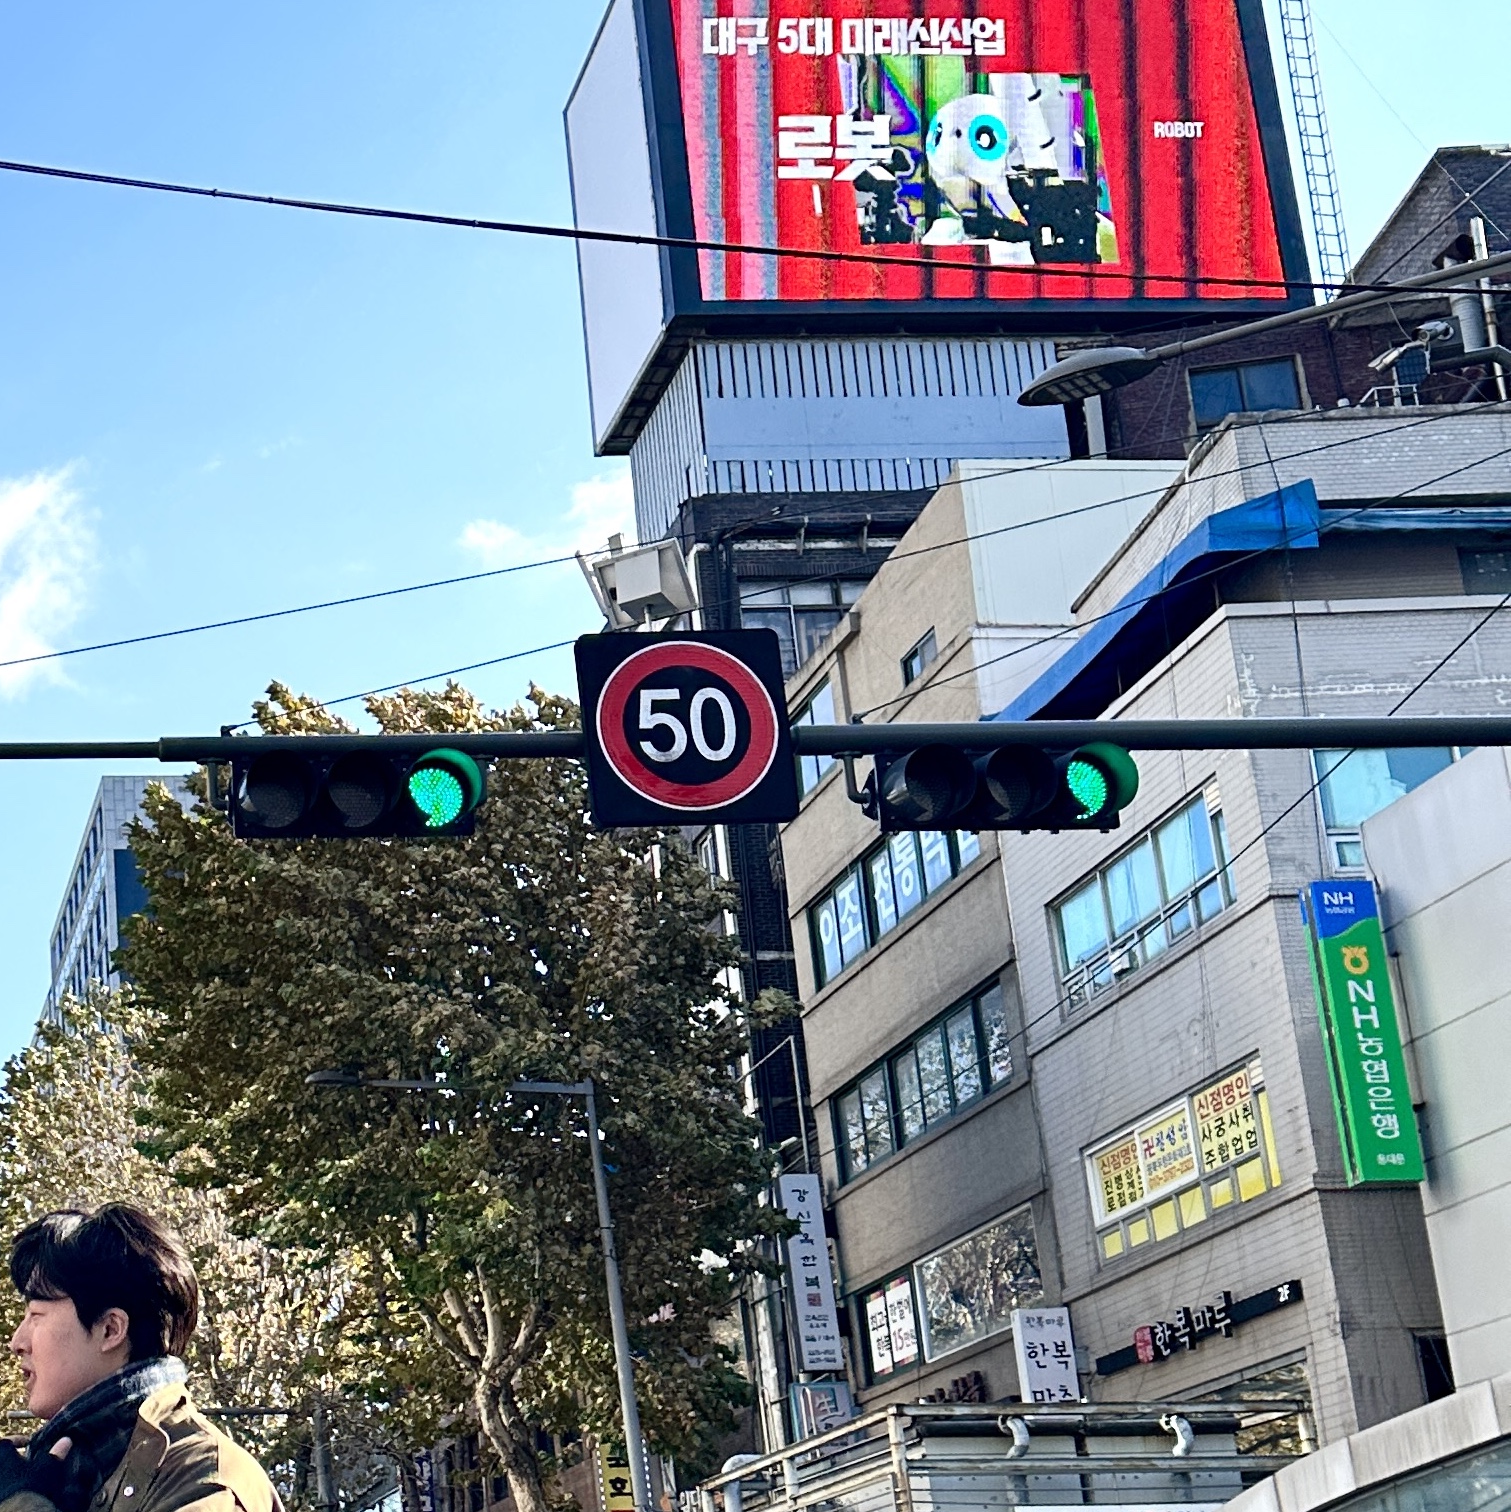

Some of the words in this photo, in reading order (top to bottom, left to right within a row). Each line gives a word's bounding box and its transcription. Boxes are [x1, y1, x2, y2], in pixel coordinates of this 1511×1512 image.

[702, 17, 768, 55] 대구
[777, 17, 834, 55] 5대
[841, 17, 1006, 56] 미래신산업
[777, 115, 895, 182] 로봇
[1153, 121, 1204, 140] ROBOT
[638, 687, 737, 763] 50
[1323, 892, 1354, 905] NH
[1347, 979, 1401, 1139] NH농협은행
[1197, 1072, 1251, 1119] 신점명인
[1154, 1291, 1231, 1356] 한복마루
[1277, 1284, 1290, 1303] 2F
[1026, 1341, 1071, 1370] 한복
